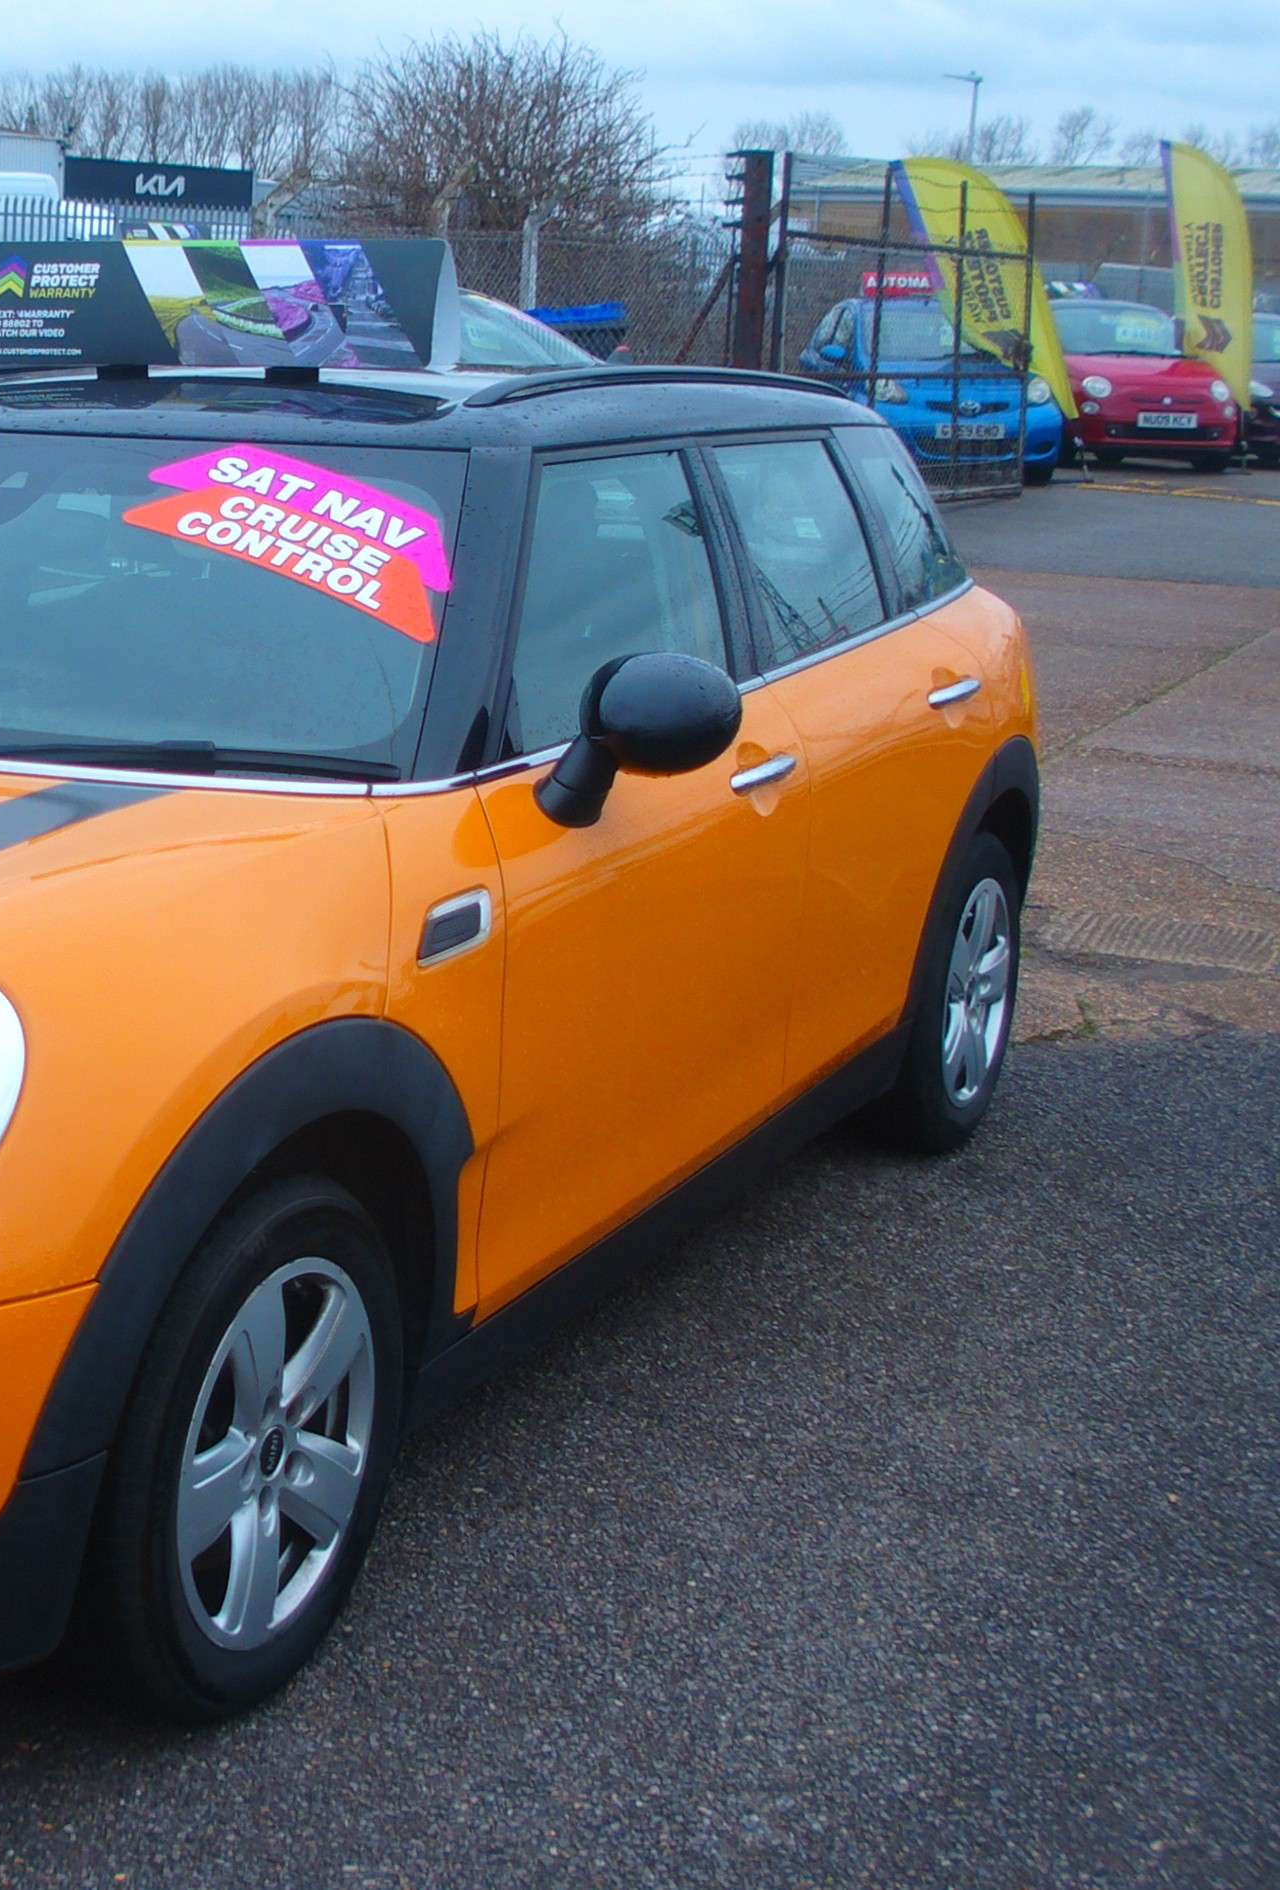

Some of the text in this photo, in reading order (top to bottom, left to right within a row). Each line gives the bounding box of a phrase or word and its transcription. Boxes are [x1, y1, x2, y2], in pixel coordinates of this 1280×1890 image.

[135, 173, 185, 197] KIA
[33, 263, 101, 274] CUSTOMER
[30, 275, 99, 287] PROTECT
[29, 288, 96, 298] WARRANTY
[32, 319, 44, 328] TO
[19, 328, 38, 338] OUR
[38, 328, 65, 338] VIDEO
[208, 456, 426, 549] SAT NAV
[219, 495, 392, 576] CRUISE
[176, 511, 385, 610] CONTROL
